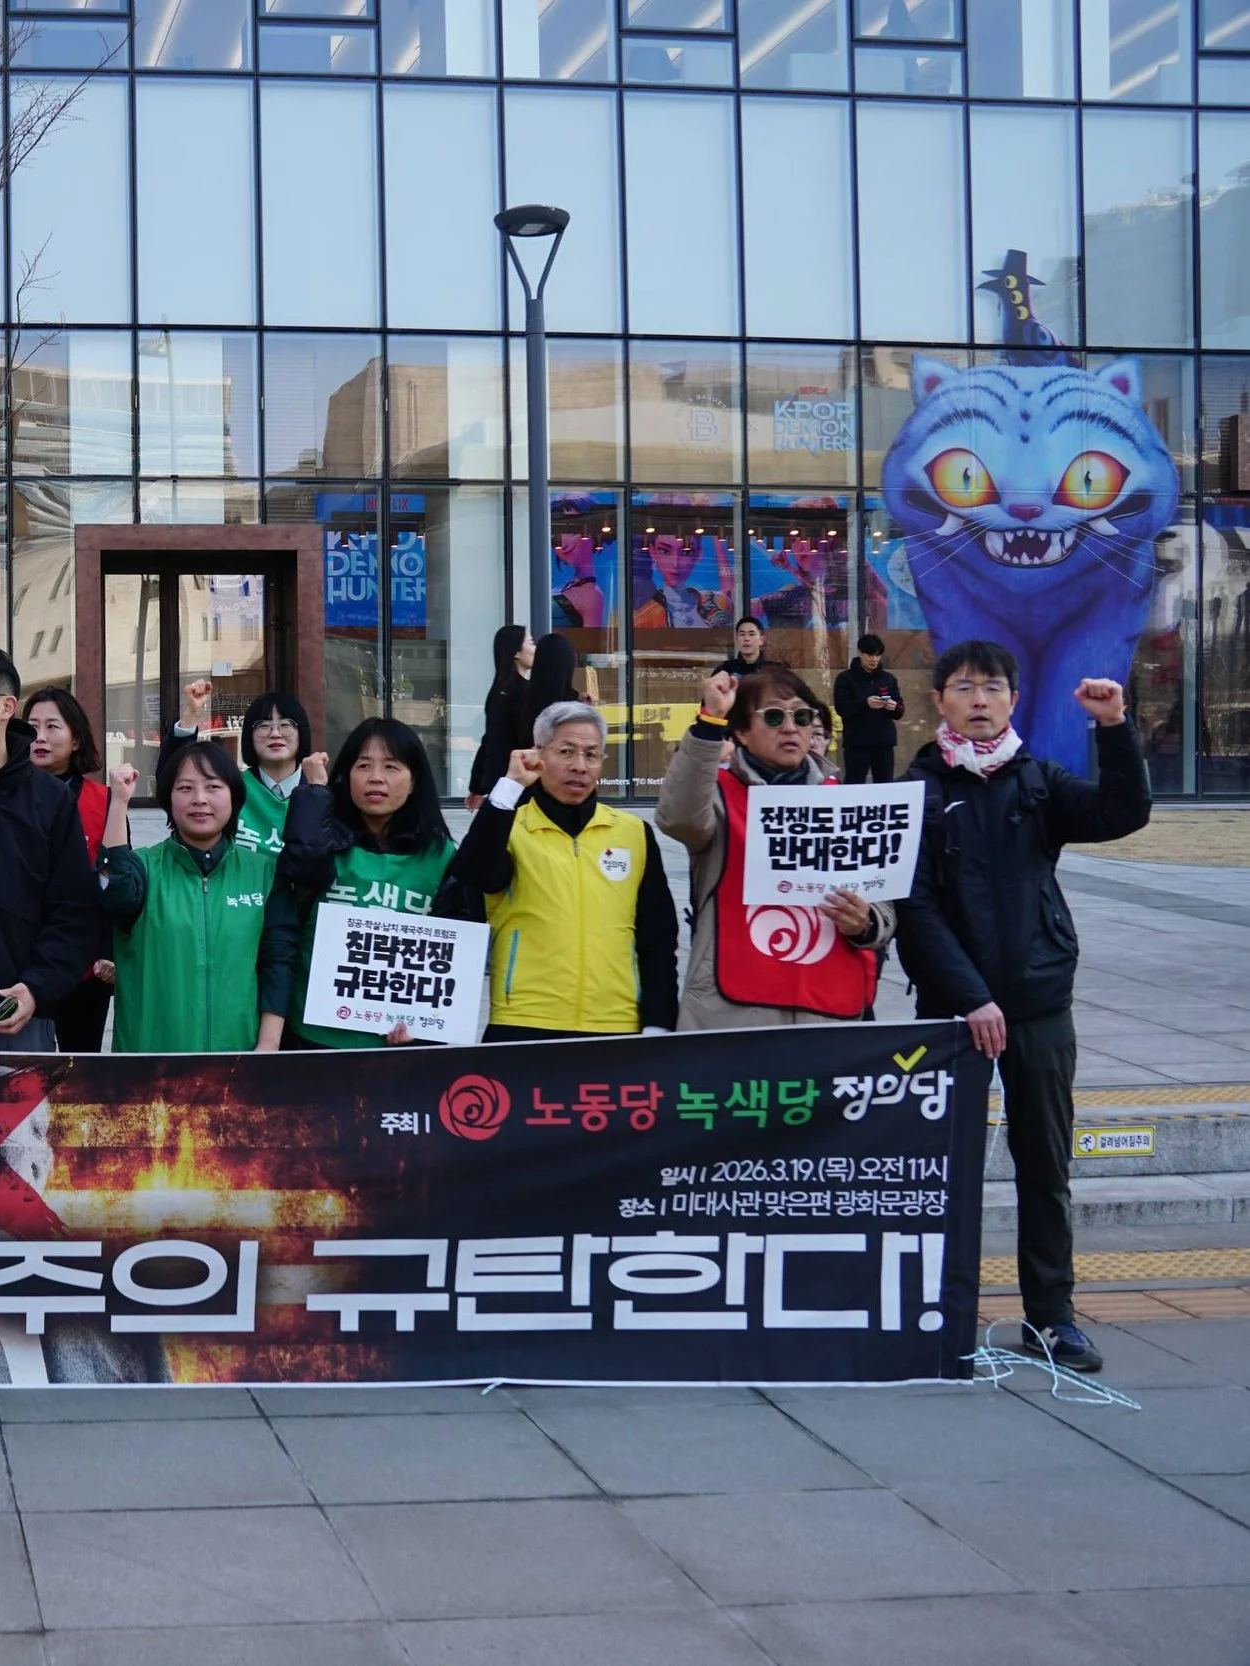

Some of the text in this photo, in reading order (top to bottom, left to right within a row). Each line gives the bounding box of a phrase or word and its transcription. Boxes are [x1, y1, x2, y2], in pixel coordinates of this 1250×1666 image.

[760, 804, 909, 835] 전쟁도 파병도
[766, 831, 902, 872] 반대한다!
[225, 892, 265, 908] 녹색당
[796, 883, 826, 893] 노동당
[399, 925, 432, 937] 제국주의
[433, 929, 457, 939] 트럼프
[345, 930, 456, 975] 침략전쟁
[334, 964, 455, 1010] 규탄한다!
[354, 1010, 383, 1022] 노동당
[419, 1017, 445, 1029] 정의당
[381, 1068, 953, 1135] 주최 노동당 녹색당 정의당
[1100, 1134, 1150, 1148] 걸려넘어짐주의
[661, 1156, 947, 1186] 일시 2026.3.19.(목) 오전 11시
[619, 1190, 948, 1218] 장소 미대사관 맞은편 광화문광장
[306, 1231, 944, 1332] 규탄한다!
